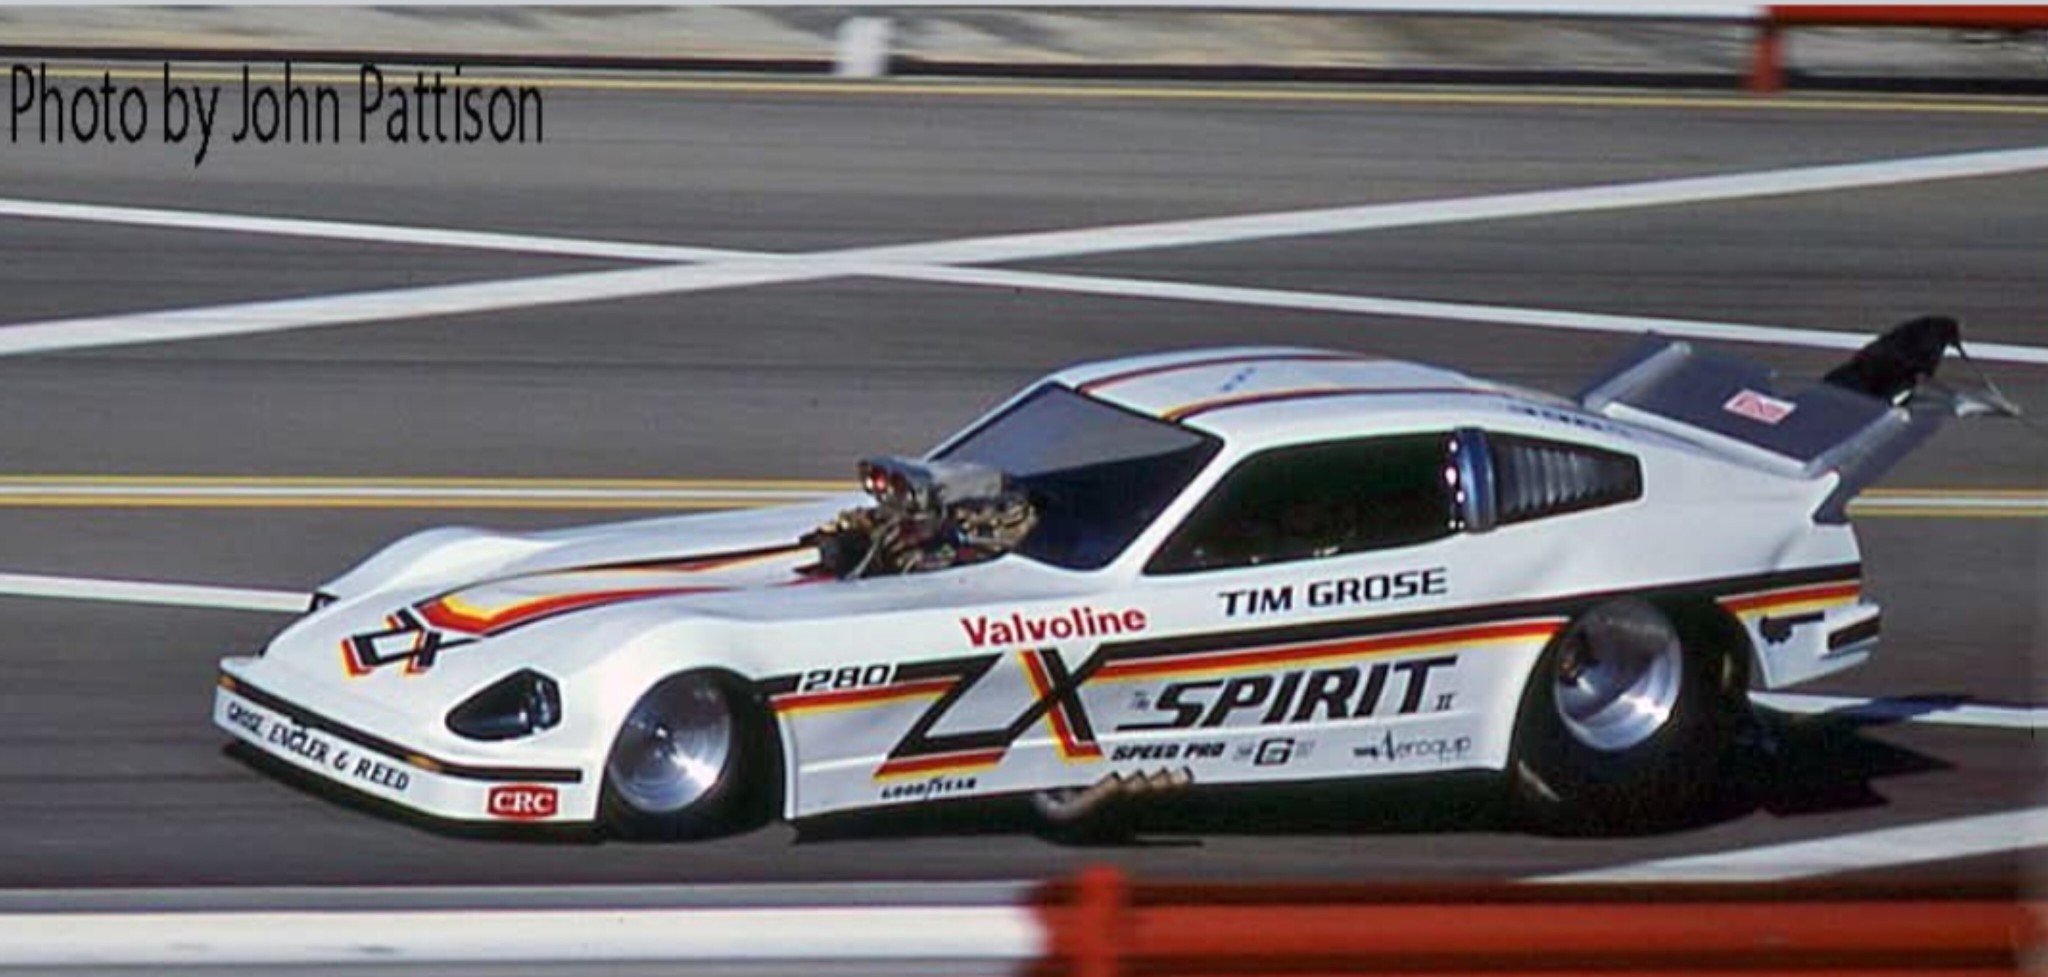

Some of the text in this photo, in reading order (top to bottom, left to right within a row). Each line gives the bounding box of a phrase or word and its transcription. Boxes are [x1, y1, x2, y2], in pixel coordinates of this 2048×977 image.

[1218, 568, 1448, 616] TIM GROSE
[961, 607, 1146, 647] Valvoline
[802, 648, 1103, 778] 280 ZX
[1115, 655, 1458, 732] SPIRIT
[1111, 744, 1180, 761] SPEED
[1183, 742, 1226, 758] PRO
[352, 758, 411, 792] REED
[493, 790, 555, 814] CRC
